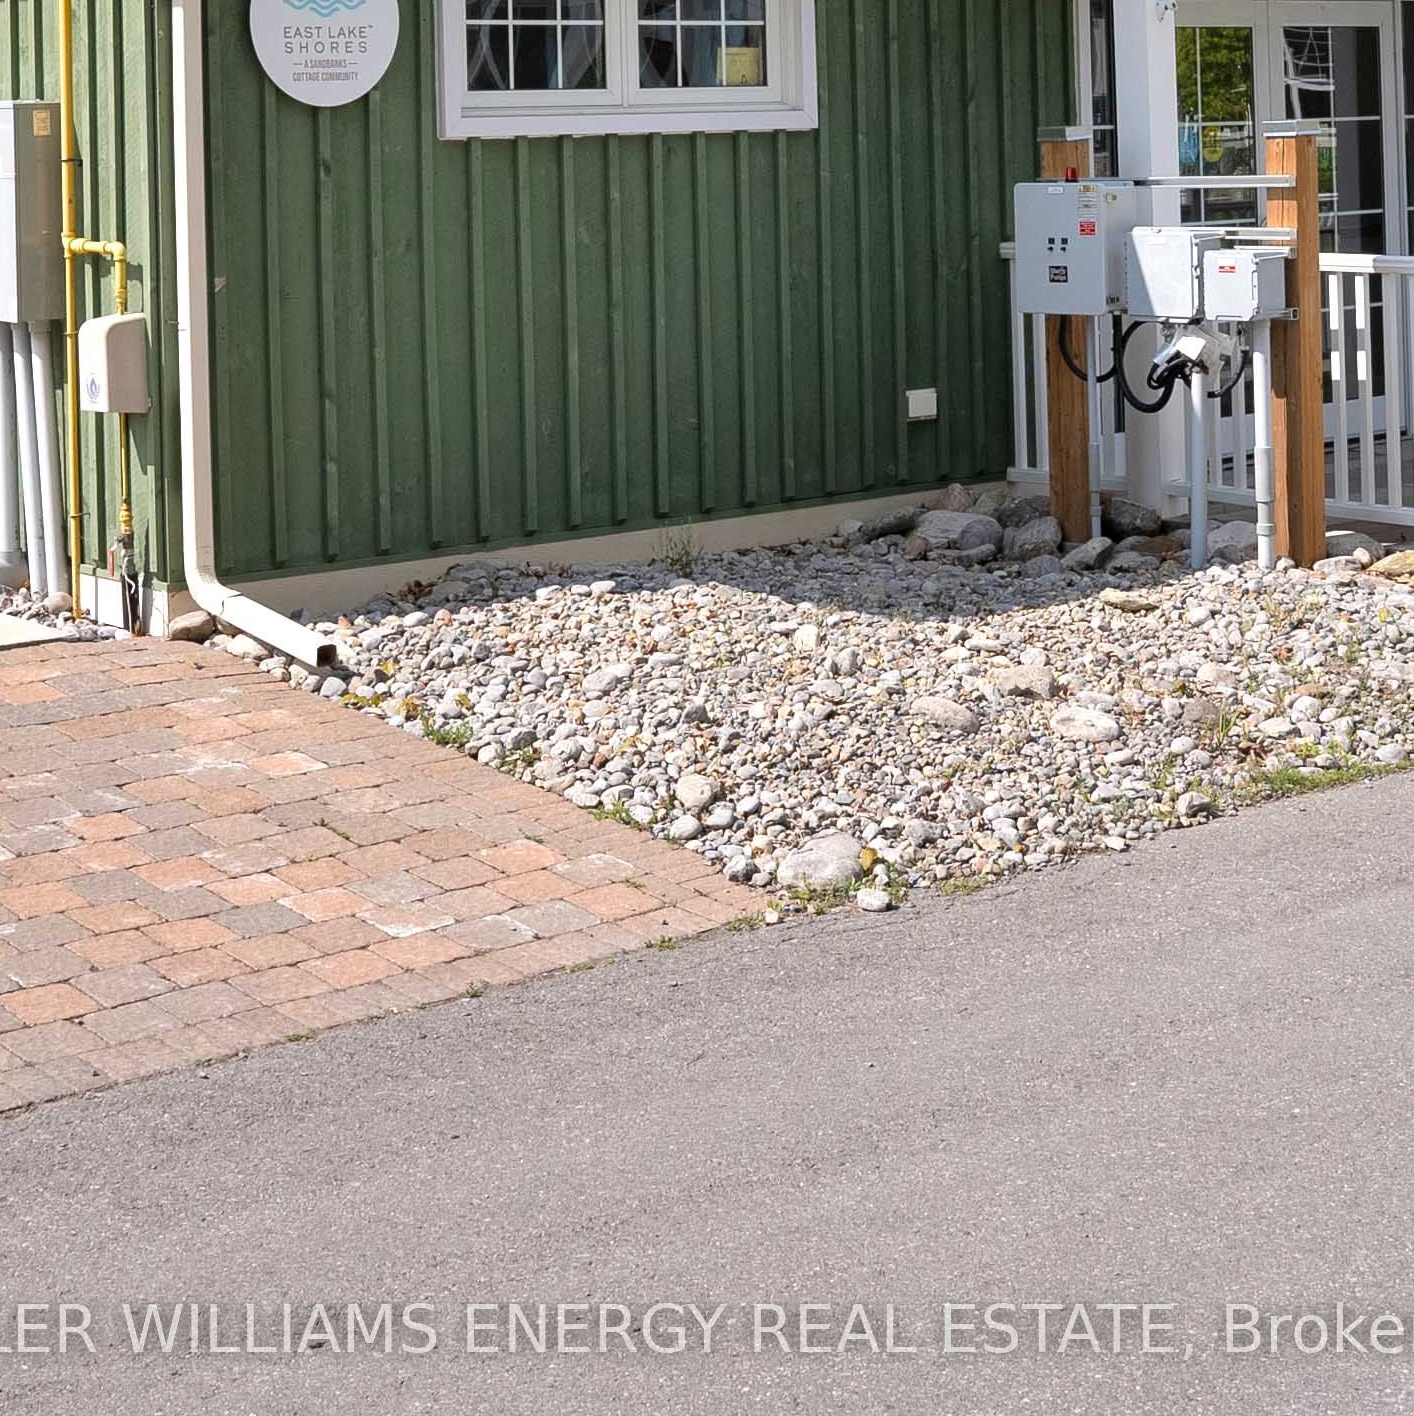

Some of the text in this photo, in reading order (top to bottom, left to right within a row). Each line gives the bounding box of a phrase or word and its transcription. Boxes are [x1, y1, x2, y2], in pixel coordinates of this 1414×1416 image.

[283, 26, 323, 39] EAST
[284, 41, 368, 54] SHORES
[292, 72, 319, 82] COTTAGE
